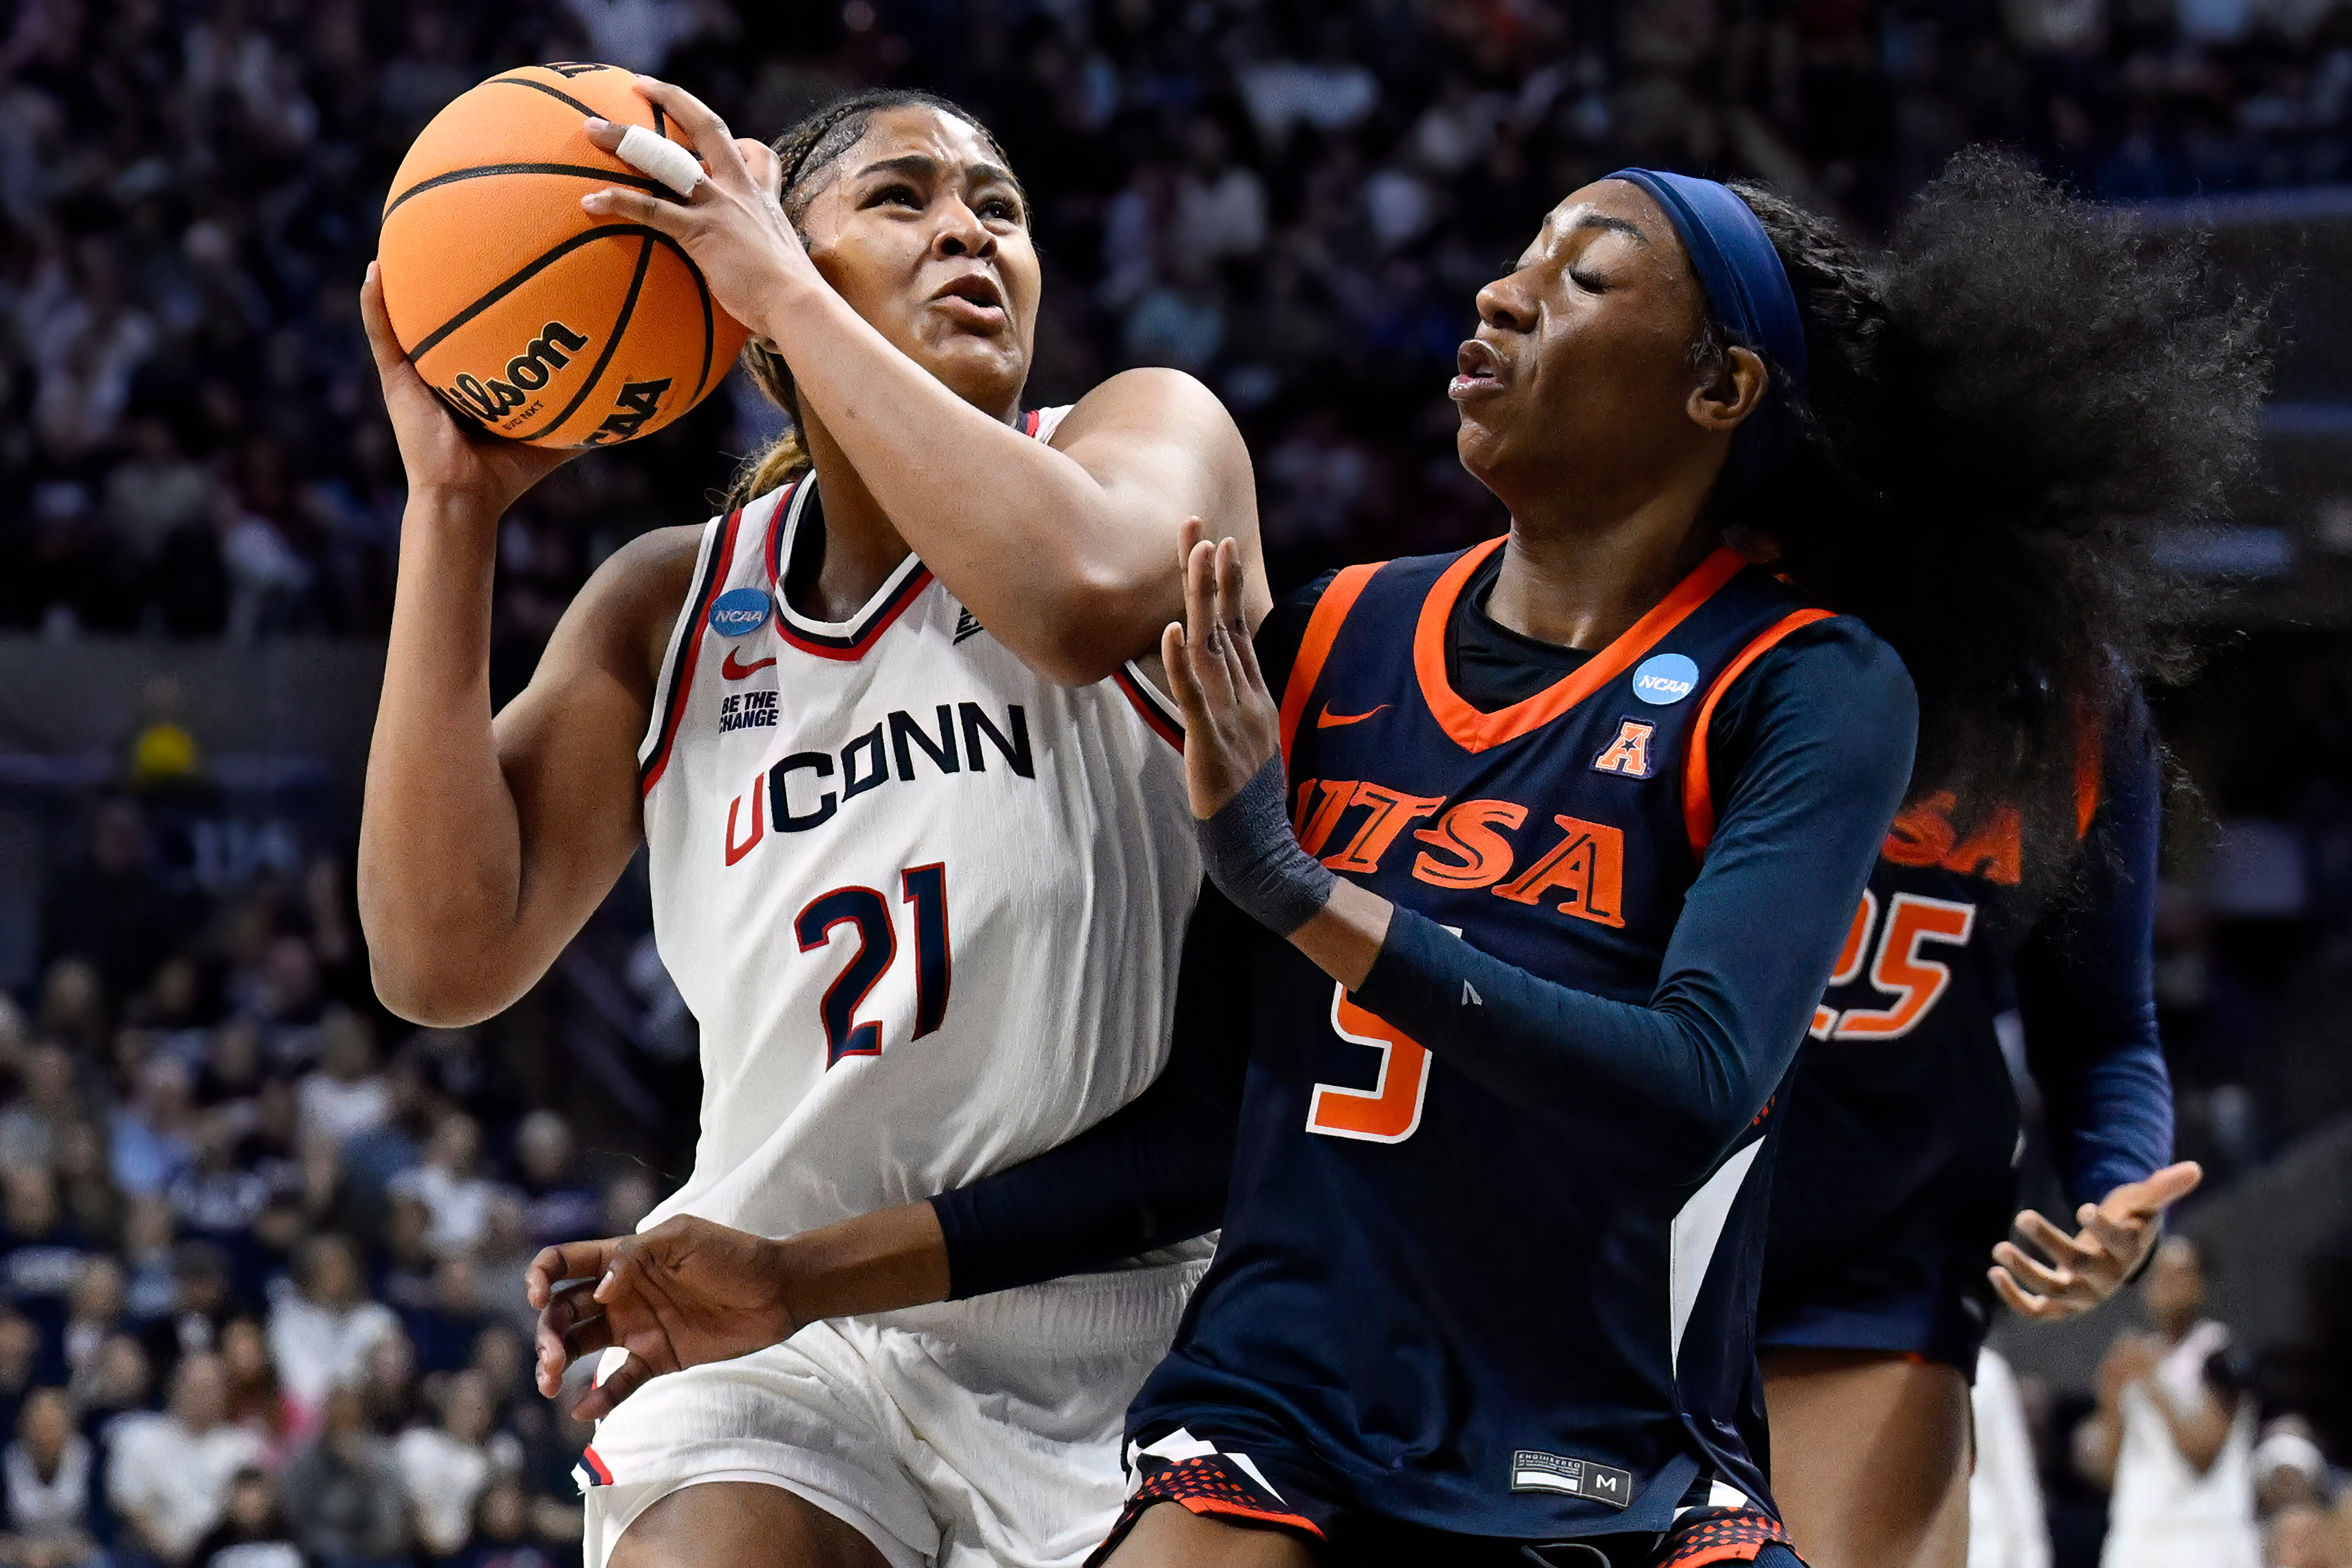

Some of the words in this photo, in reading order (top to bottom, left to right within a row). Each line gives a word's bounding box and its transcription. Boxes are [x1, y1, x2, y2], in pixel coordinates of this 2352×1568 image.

[435, 321, 590, 422] ilson
[520, 400, 544, 419] NXT
[715, 611, 763, 622] NCAA
[1639, 675, 1689, 695] NCAA
[722, 695, 740, 715] BE
[744, 691, 779, 710] THE
[726, 702, 1035, 867] UCONN
[1881, 791, 2021, 885] SA
[793, 862, 952, 1073] 21
[1596, 1474, 1616, 1492] M
